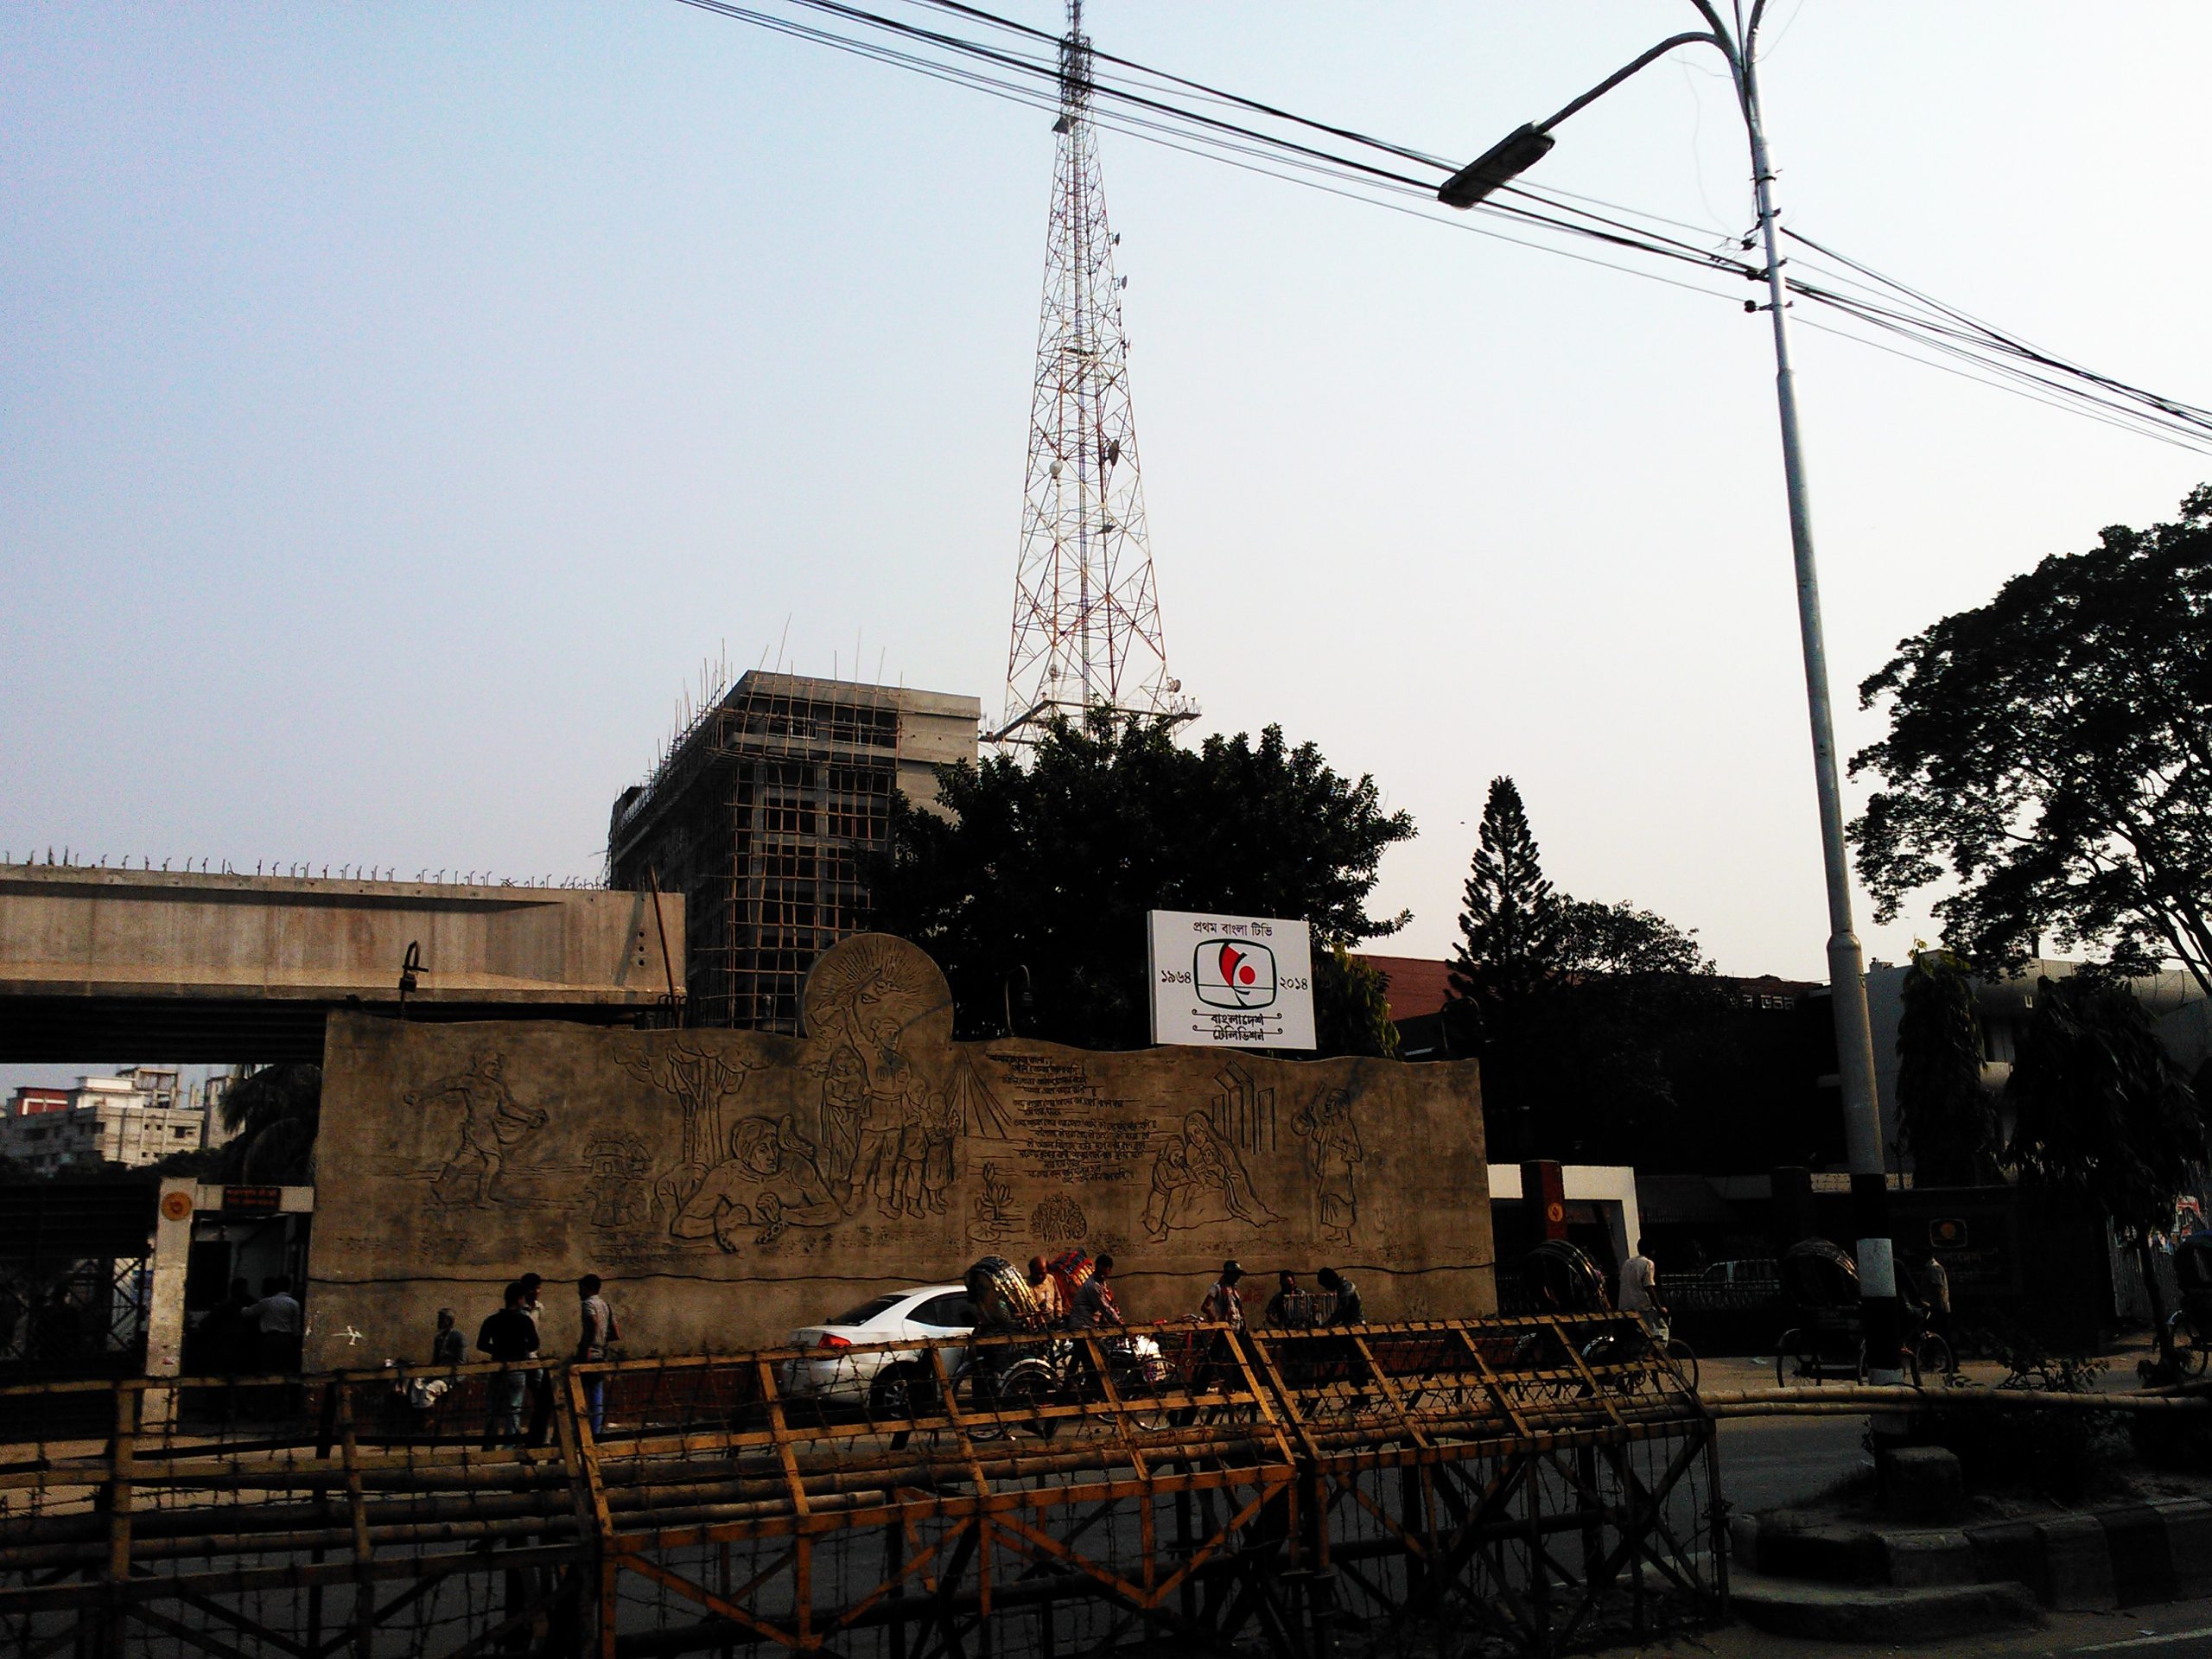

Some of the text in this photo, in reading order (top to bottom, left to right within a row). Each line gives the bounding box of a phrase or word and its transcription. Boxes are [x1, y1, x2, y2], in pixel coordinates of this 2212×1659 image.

[1193, 921, 1273, 937] প্রথম বাংলা টিভি
[1160, 969, 1192, 984] ১৯৬৪
[1279, 976, 1308, 991] ২০১৪
[1211, 1013, 1265, 1027] বাংলাদেশ
[1212, 1025, 1265, 1041] টেলিভিশন
